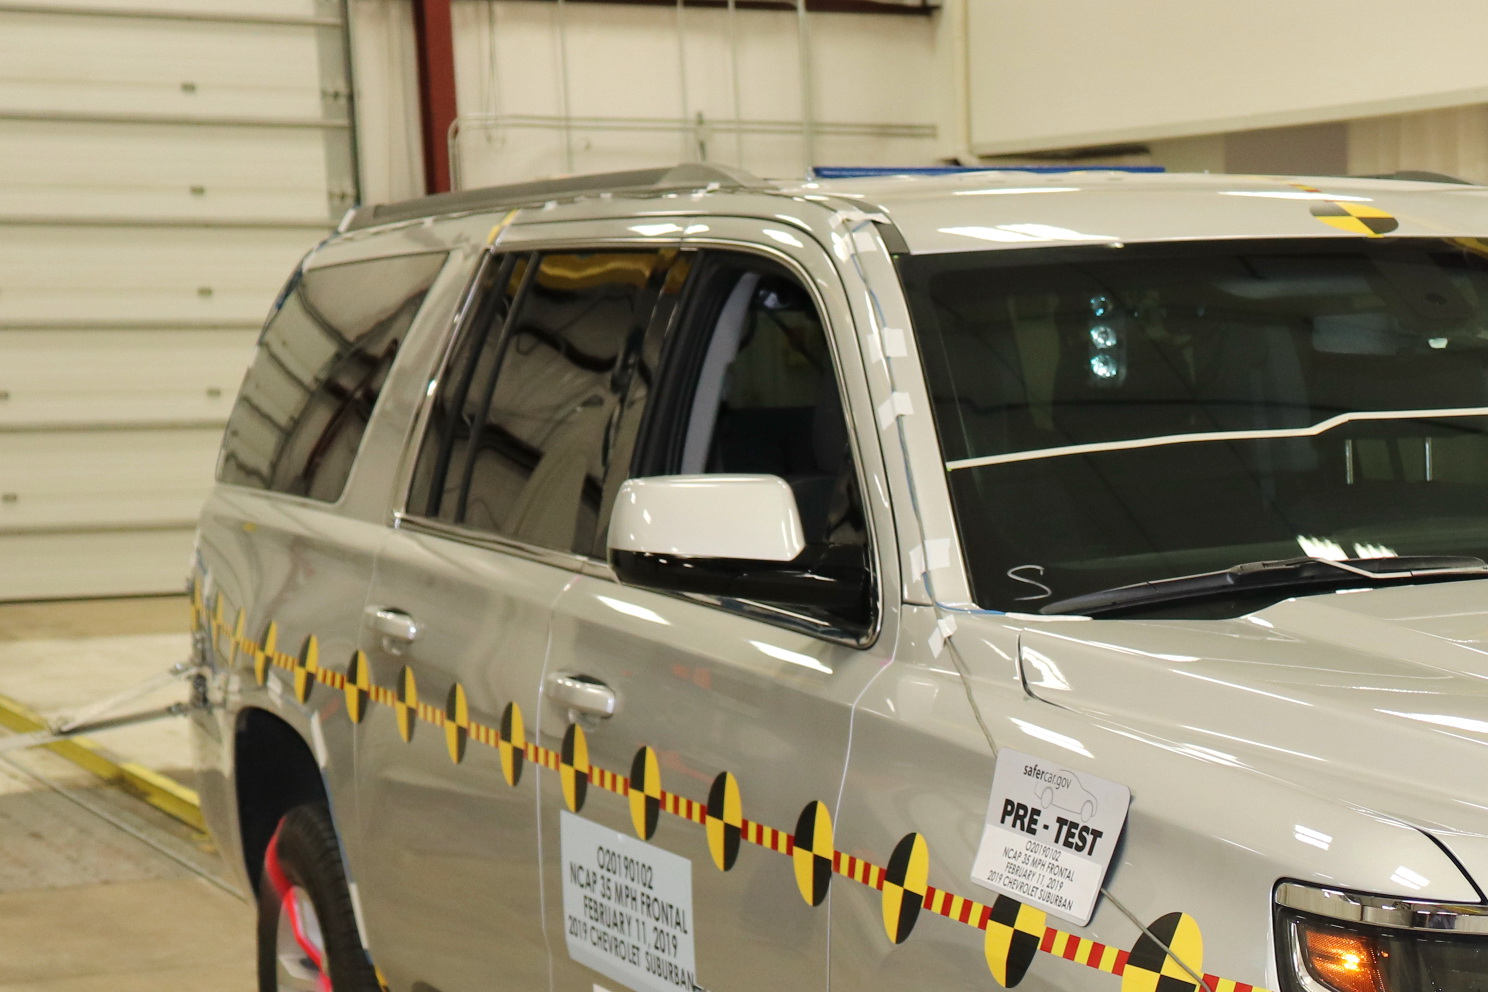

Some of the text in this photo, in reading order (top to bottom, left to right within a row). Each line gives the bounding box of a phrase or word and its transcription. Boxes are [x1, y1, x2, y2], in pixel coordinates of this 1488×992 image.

[1023, 764, 1072, 789] safercar.gov
[1000, 798, 1041, 835] PRE
[1054, 816, 1103, 856] TEST
[1002, 846, 1074, 882] NCAP 35 MPH FRONTAL
[1005, 861, 1036, 882] FEBRUARY
[1047, 876, 1064, 891] 2019
[569, 861, 688, 935] NCAP 35 MPH FRONTAL
[987, 870, 1074, 911] 2019 CHEVROLET SUBURBAN
[583, 895, 633, 933] FEBRUARY
[653, 928, 678, 958] 2019
[568, 915, 695, 992] 2019 CHEVROLET SUBURBAN
